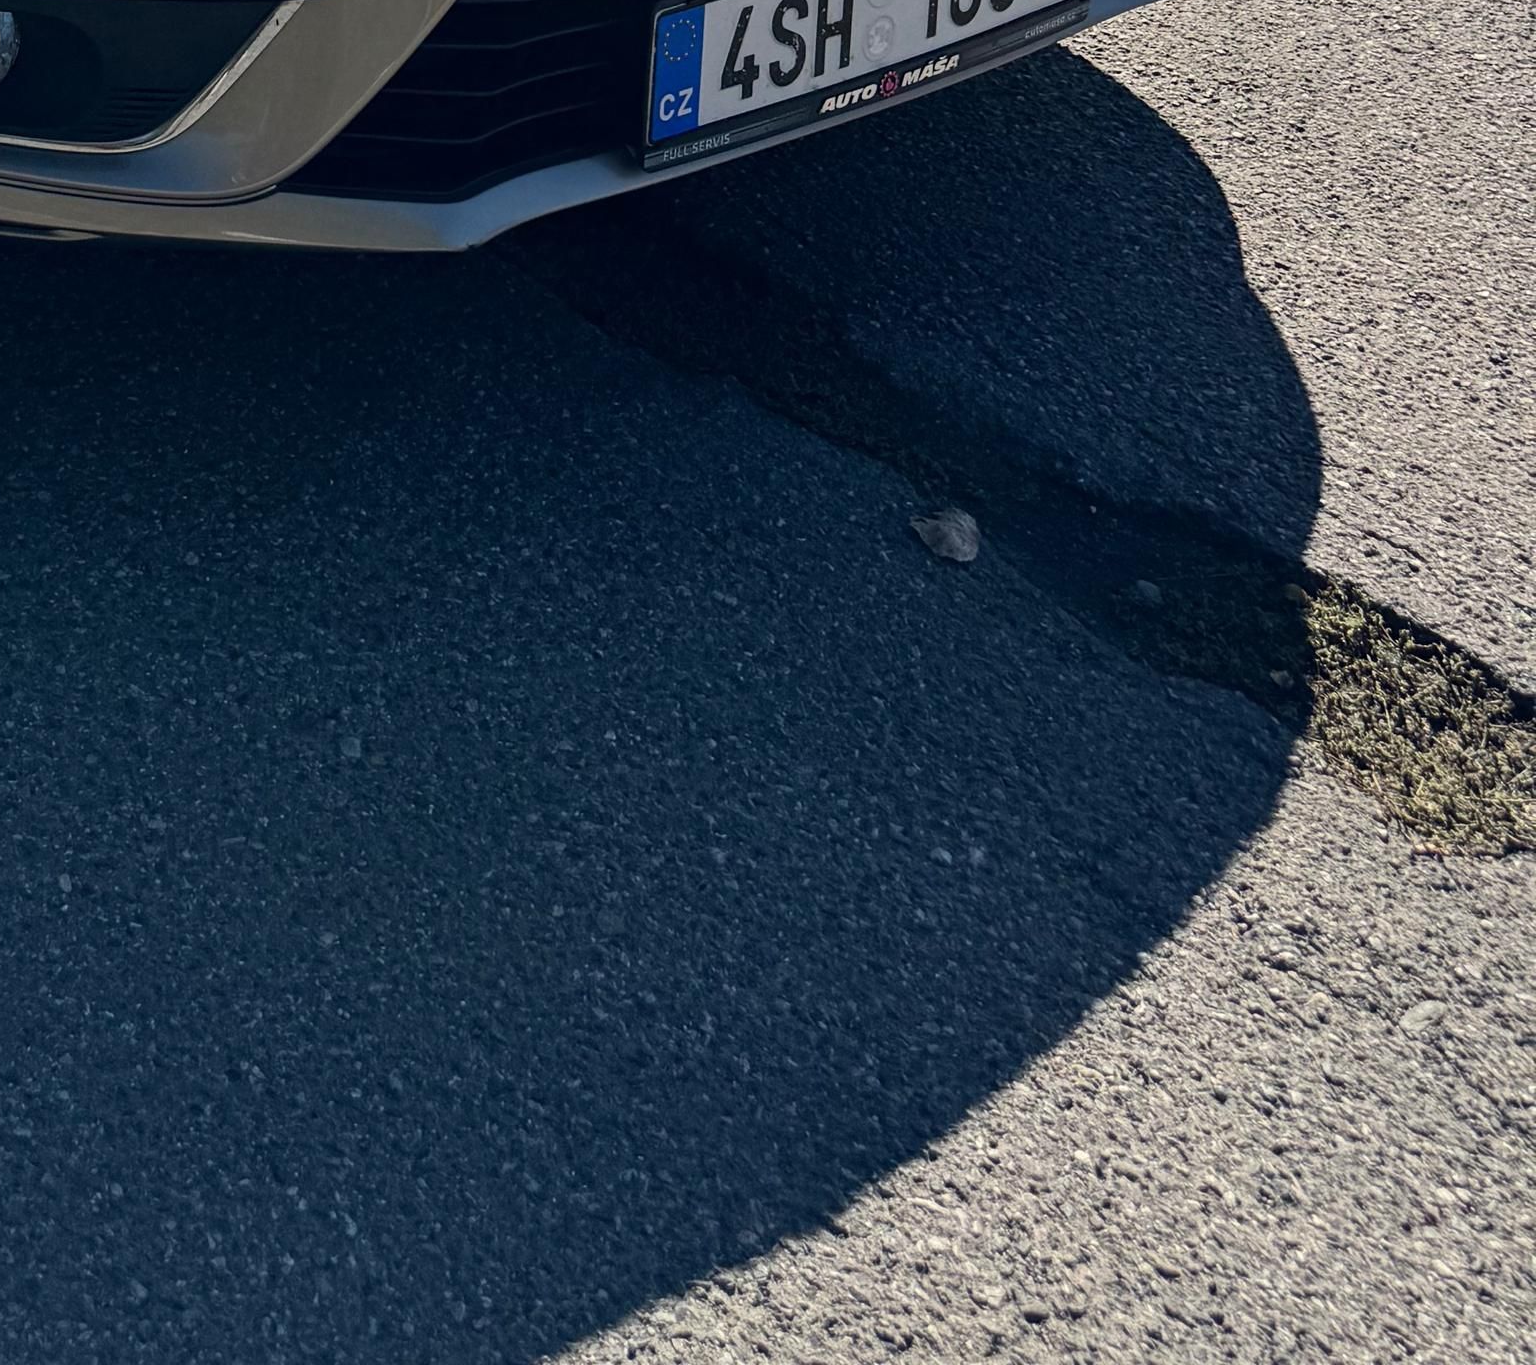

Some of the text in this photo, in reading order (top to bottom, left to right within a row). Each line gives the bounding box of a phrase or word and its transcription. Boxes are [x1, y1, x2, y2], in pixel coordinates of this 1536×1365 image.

[818, 53, 960, 115] AUTO MÁŠA
[659, 87, 693, 121] CZ
[663, 132, 731, 162] FULL SERVIS
